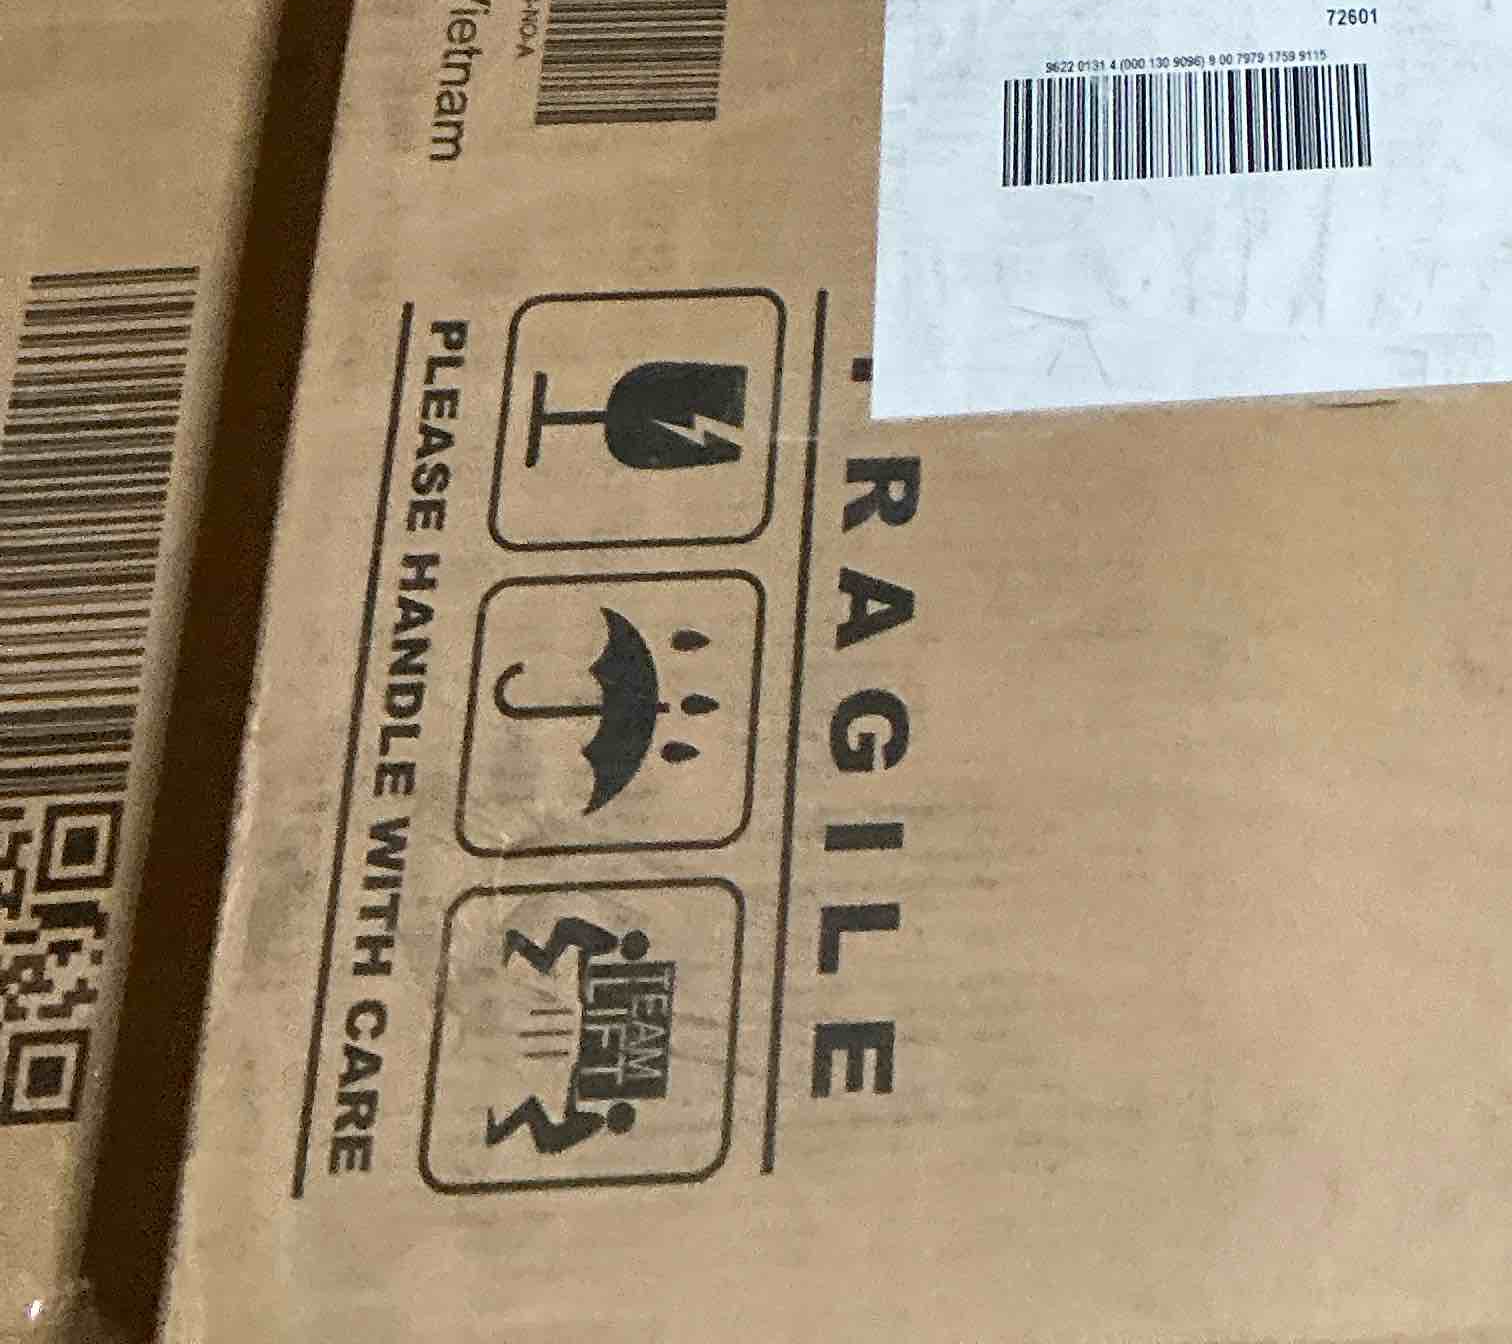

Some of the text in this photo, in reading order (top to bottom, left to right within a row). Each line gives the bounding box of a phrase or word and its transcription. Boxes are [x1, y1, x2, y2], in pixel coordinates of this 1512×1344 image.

[1236, 52, 1265, 65] 7979
[1268, 51, 1296, 63] 1759
[1326, 8, 1378, 26] 72601
[326, 318, 469, 1178] PLEASE HANDLE WITH CARE
[811, 358, 922, 1098] RAGILE
[580, 976, 628, 1086] LIFT
[626, 967, 671, 1079] TEAM
